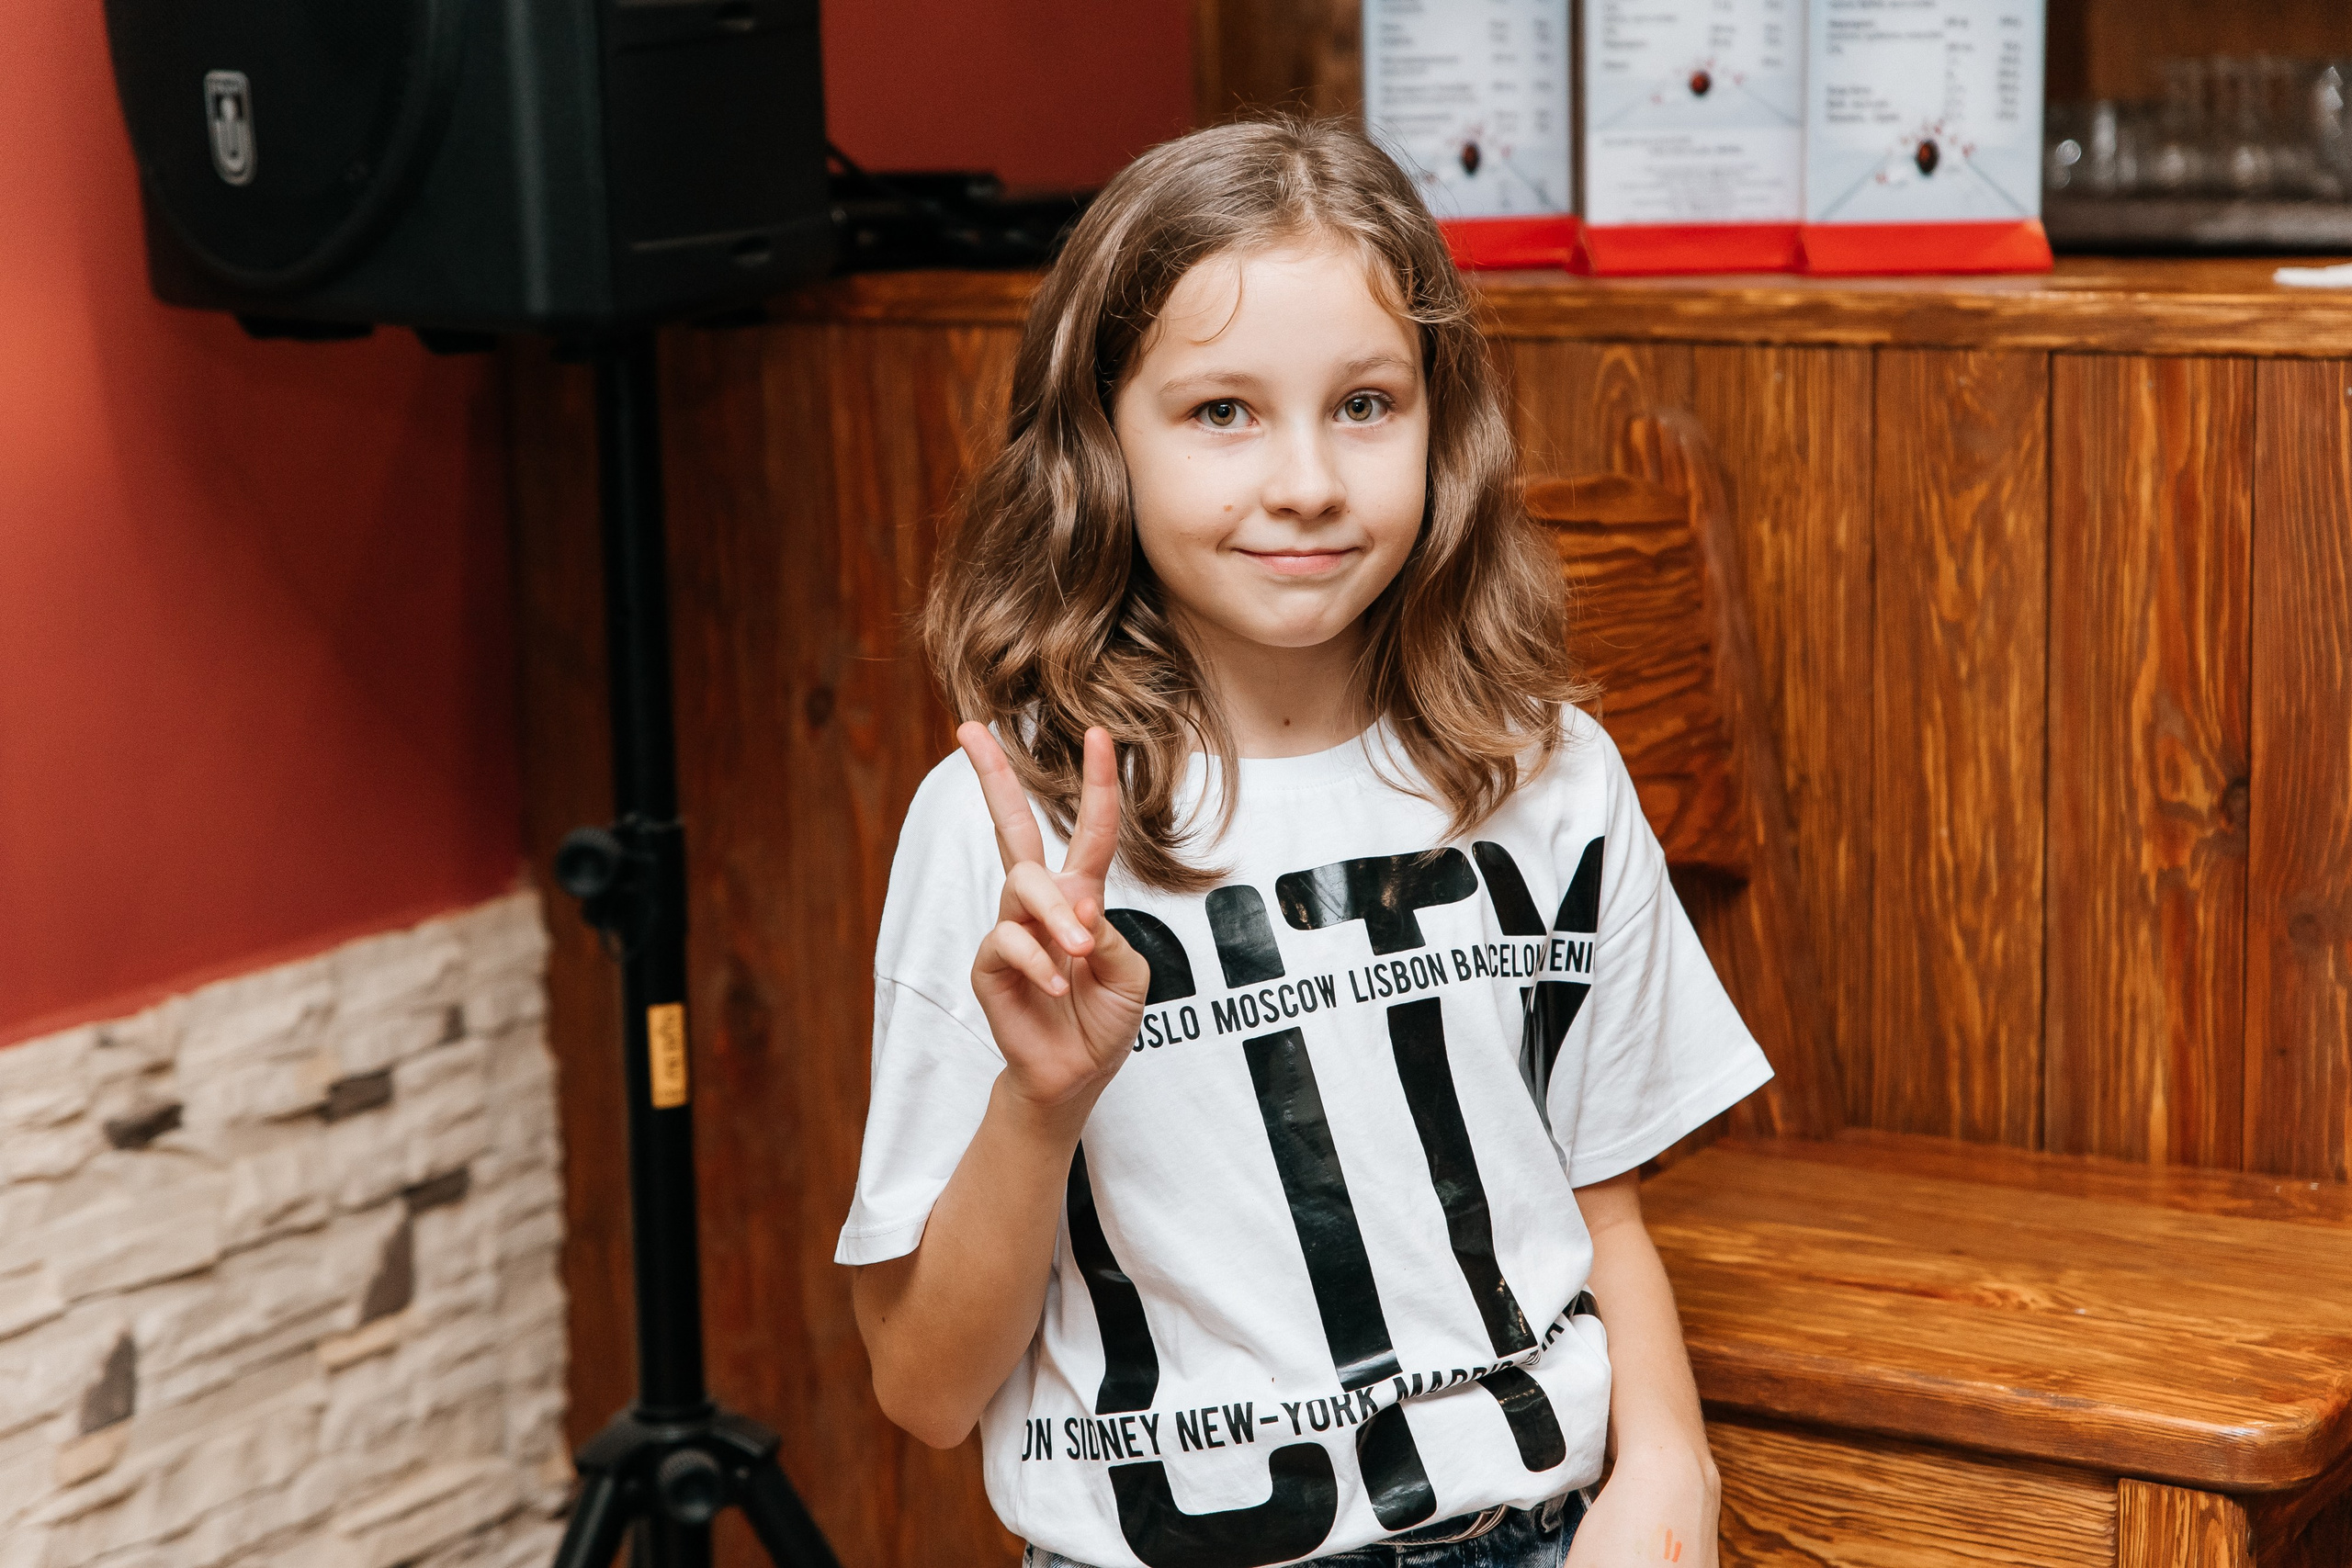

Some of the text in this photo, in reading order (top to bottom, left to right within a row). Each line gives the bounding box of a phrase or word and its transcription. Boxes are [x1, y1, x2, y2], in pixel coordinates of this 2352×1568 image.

[1210, 974, 1338, 1035] MOSCOW
[1348, 953, 1449, 1003] LISBON
[1064, 1413, 1161, 1461] SIDNEY
[1175, 1385, 1379, 1452] NEW-YORK
